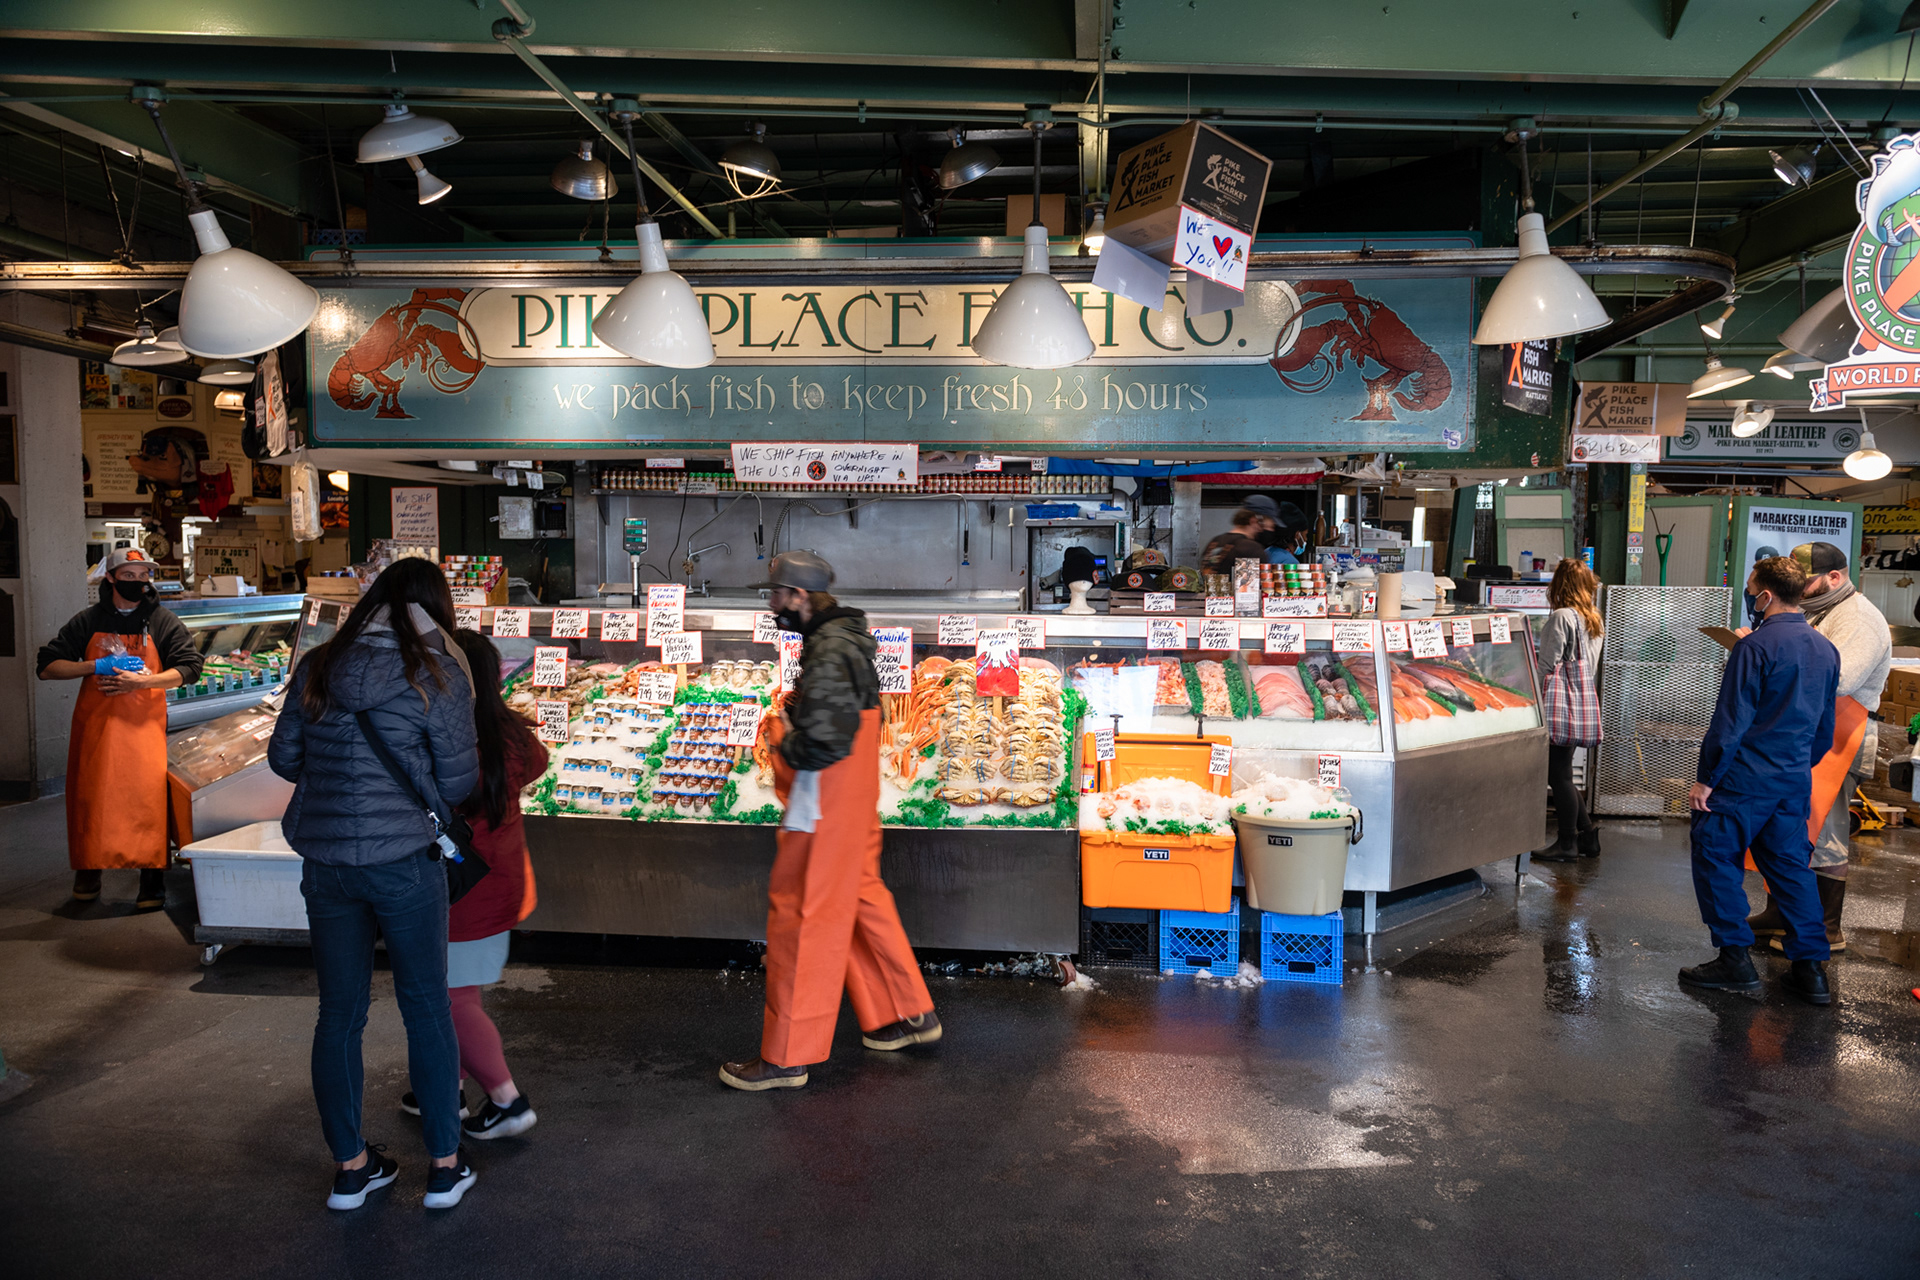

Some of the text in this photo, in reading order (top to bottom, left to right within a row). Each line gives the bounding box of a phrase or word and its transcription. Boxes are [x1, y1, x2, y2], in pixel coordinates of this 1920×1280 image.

[1144, 142, 1166, 160] PIKE
[1141, 151, 1173, 173] PLACE
[1224, 158, 1241, 172] PIKE
[1137, 169, 1159, 186] FISH
[1220, 174, 1237, 187] FISH
[1222, 166, 1246, 184] PLACE
[1135, 175, 1175, 199] MARKET
[1219, 182, 1248, 202] MARKET
[1853, 241, 1917, 346] PIKE PLACE
[511, 294, 619, 348] PIK
[957, 289, 1119, 347] FH
[1523, 347, 1540, 367] FISH
[89, 375, 108, 386] YES
[1833, 367, 1909, 386] WORLD
[1612, 386, 1637, 394] PIKE
[552, 373, 1208, 421] we pack fish to keep fresh 48 hours
[1610, 396, 1648, 405] PLACE
[1609, 406, 1634, 415] FISH
[1608, 416, 1654, 426] MARKET
[1775, 425, 1826, 440] LEATHER
[739, 447, 762, 461] WE
[739, 465, 761, 477] THE
[834, 463, 890, 474] OVERNIGHT
[833, 474, 849, 482] VIA
[1753, 512, 1806, 526] MARAKESH
[1808, 515, 1848, 529] LEATHER
[1760, 524, 1840, 536] ROCKING SEATTLE SINCE 1971
[204, 548, 219, 556] DON
[229, 549, 249, 557] JOE'S
[214, 567, 239, 575] MEATS
[876, 654, 902, 664] SNOW
[875, 664, 899, 674] CRAB
[1269, 837, 1292, 846] YETI
[1145, 850, 1168, 860] YETI
